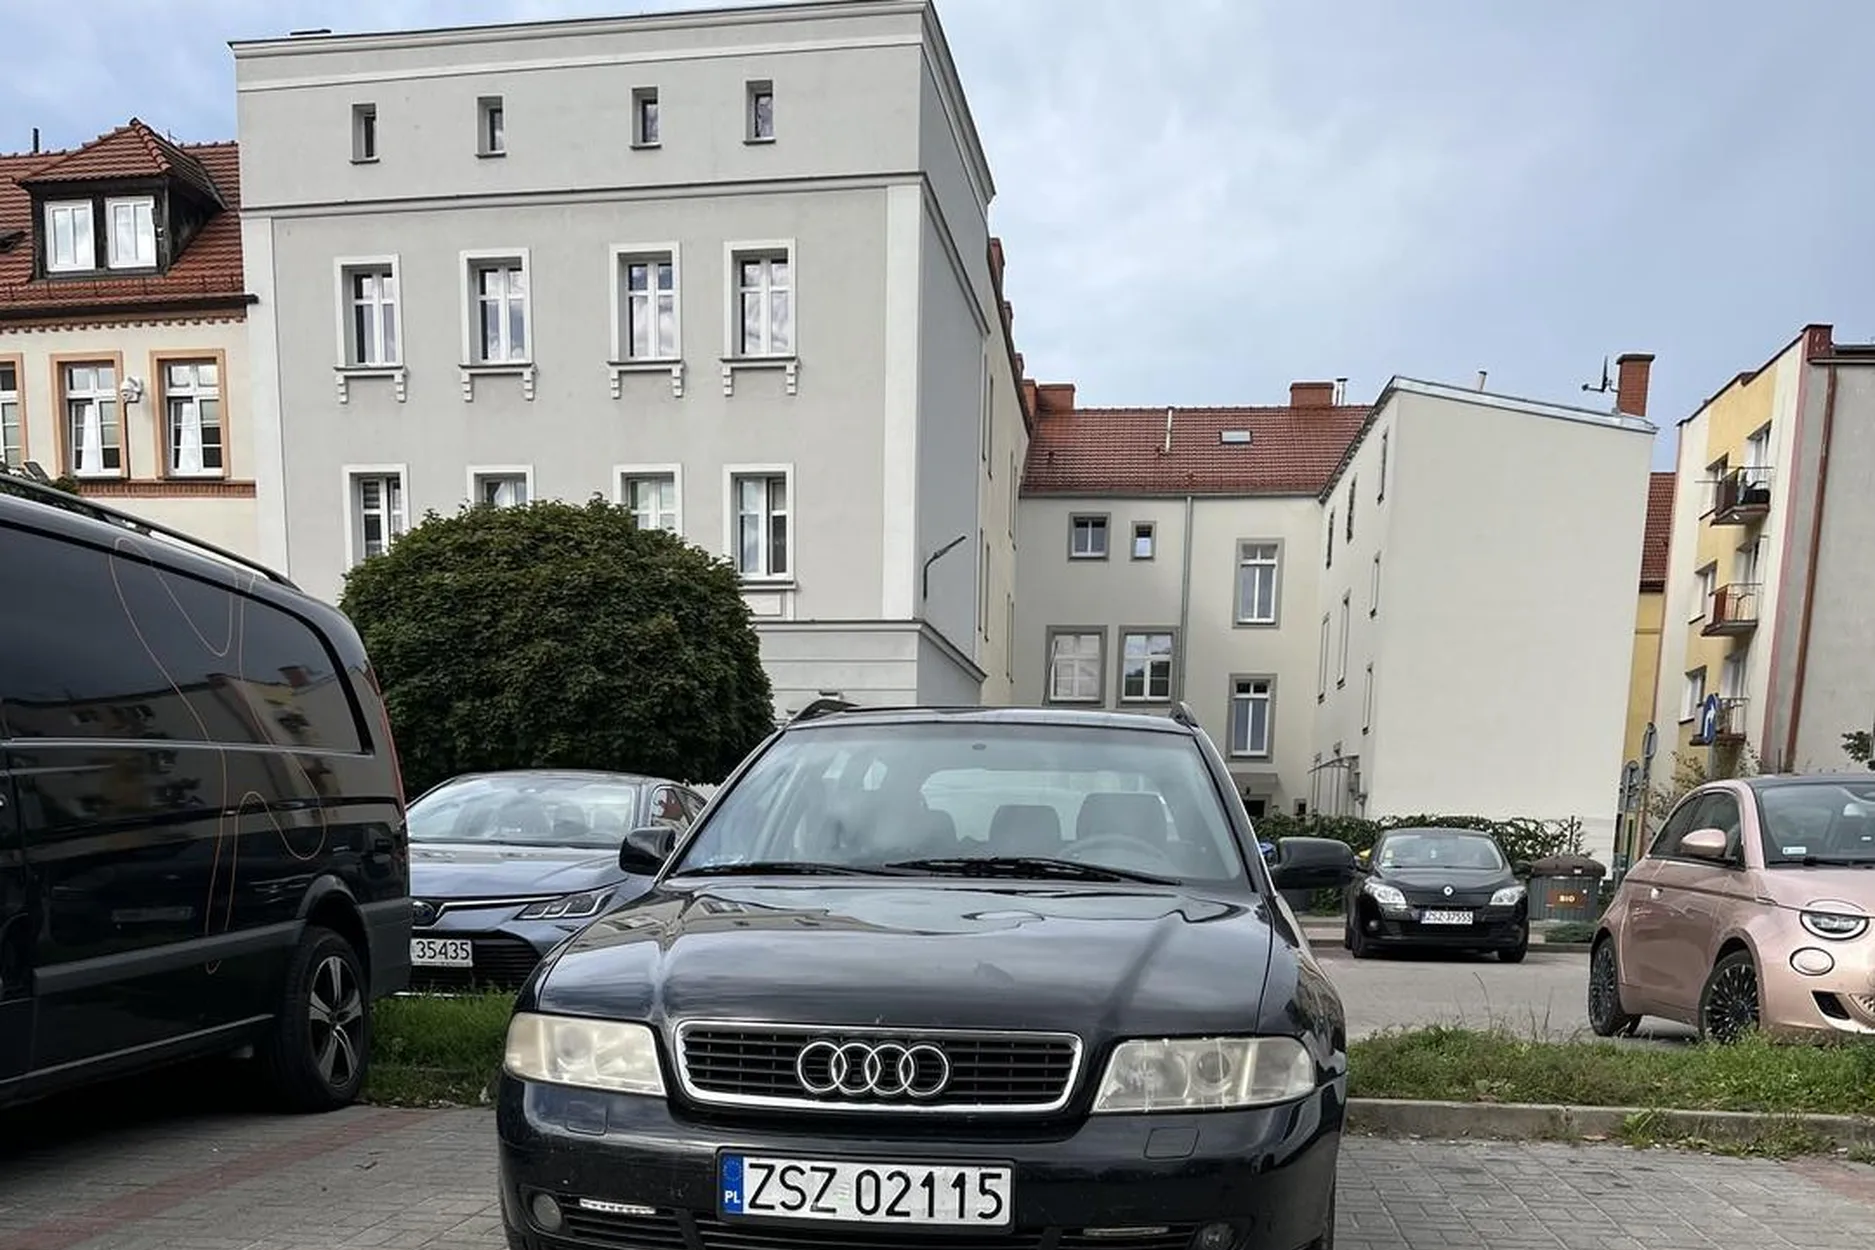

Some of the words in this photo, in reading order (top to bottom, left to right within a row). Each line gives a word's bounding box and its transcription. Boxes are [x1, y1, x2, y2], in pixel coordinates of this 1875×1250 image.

[416, 941, 470, 960] 35435
[725, 1190, 741, 1204] PL
[748, 1163, 838, 1213] ZSZ
[855, 1169, 1004, 1219] 02115
